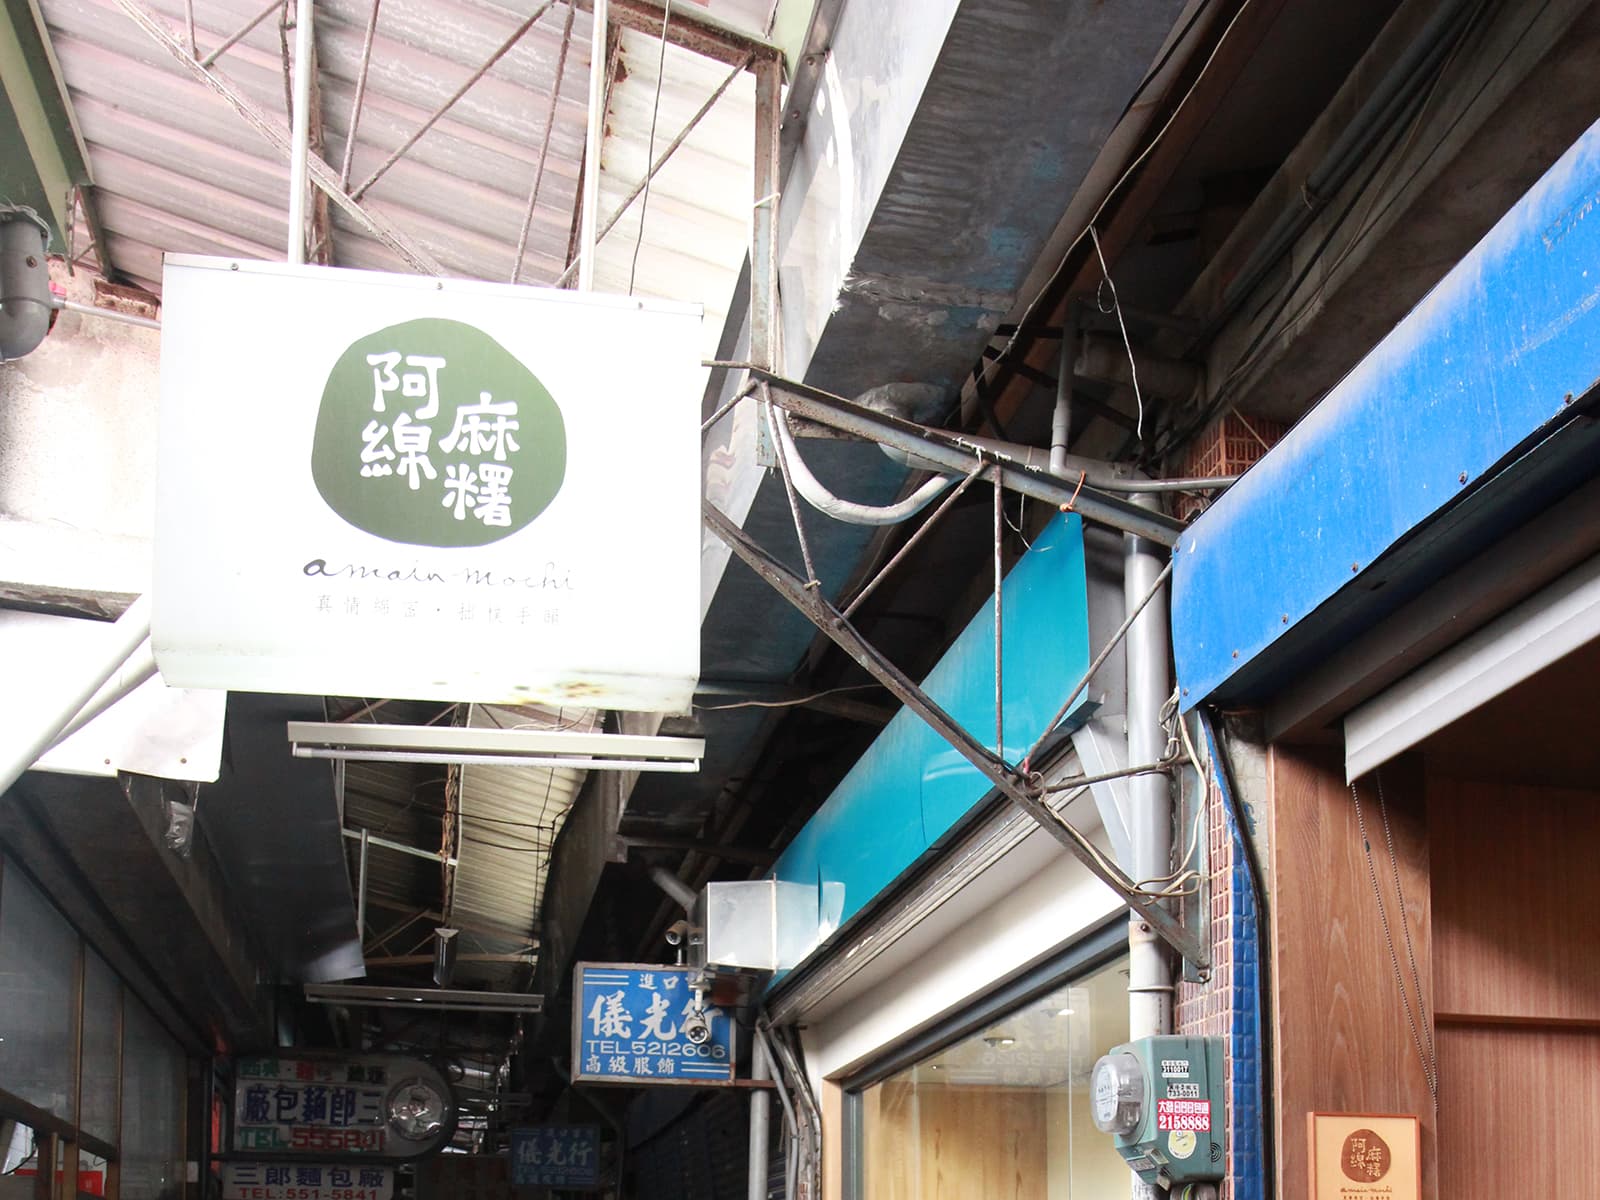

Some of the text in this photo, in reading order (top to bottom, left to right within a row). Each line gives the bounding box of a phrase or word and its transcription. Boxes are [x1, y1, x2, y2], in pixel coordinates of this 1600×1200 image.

[360, 351, 447, 490] 阿綿
[439, 391, 521, 527] 麻糬
[587, 989, 724, 1044] 儀光行
[585, 1055, 676, 1075] 高級服飾
[1159, 1115, 1210, 1130] 2158888
[232, 1167, 385, 1188] 三郎麵包廠
